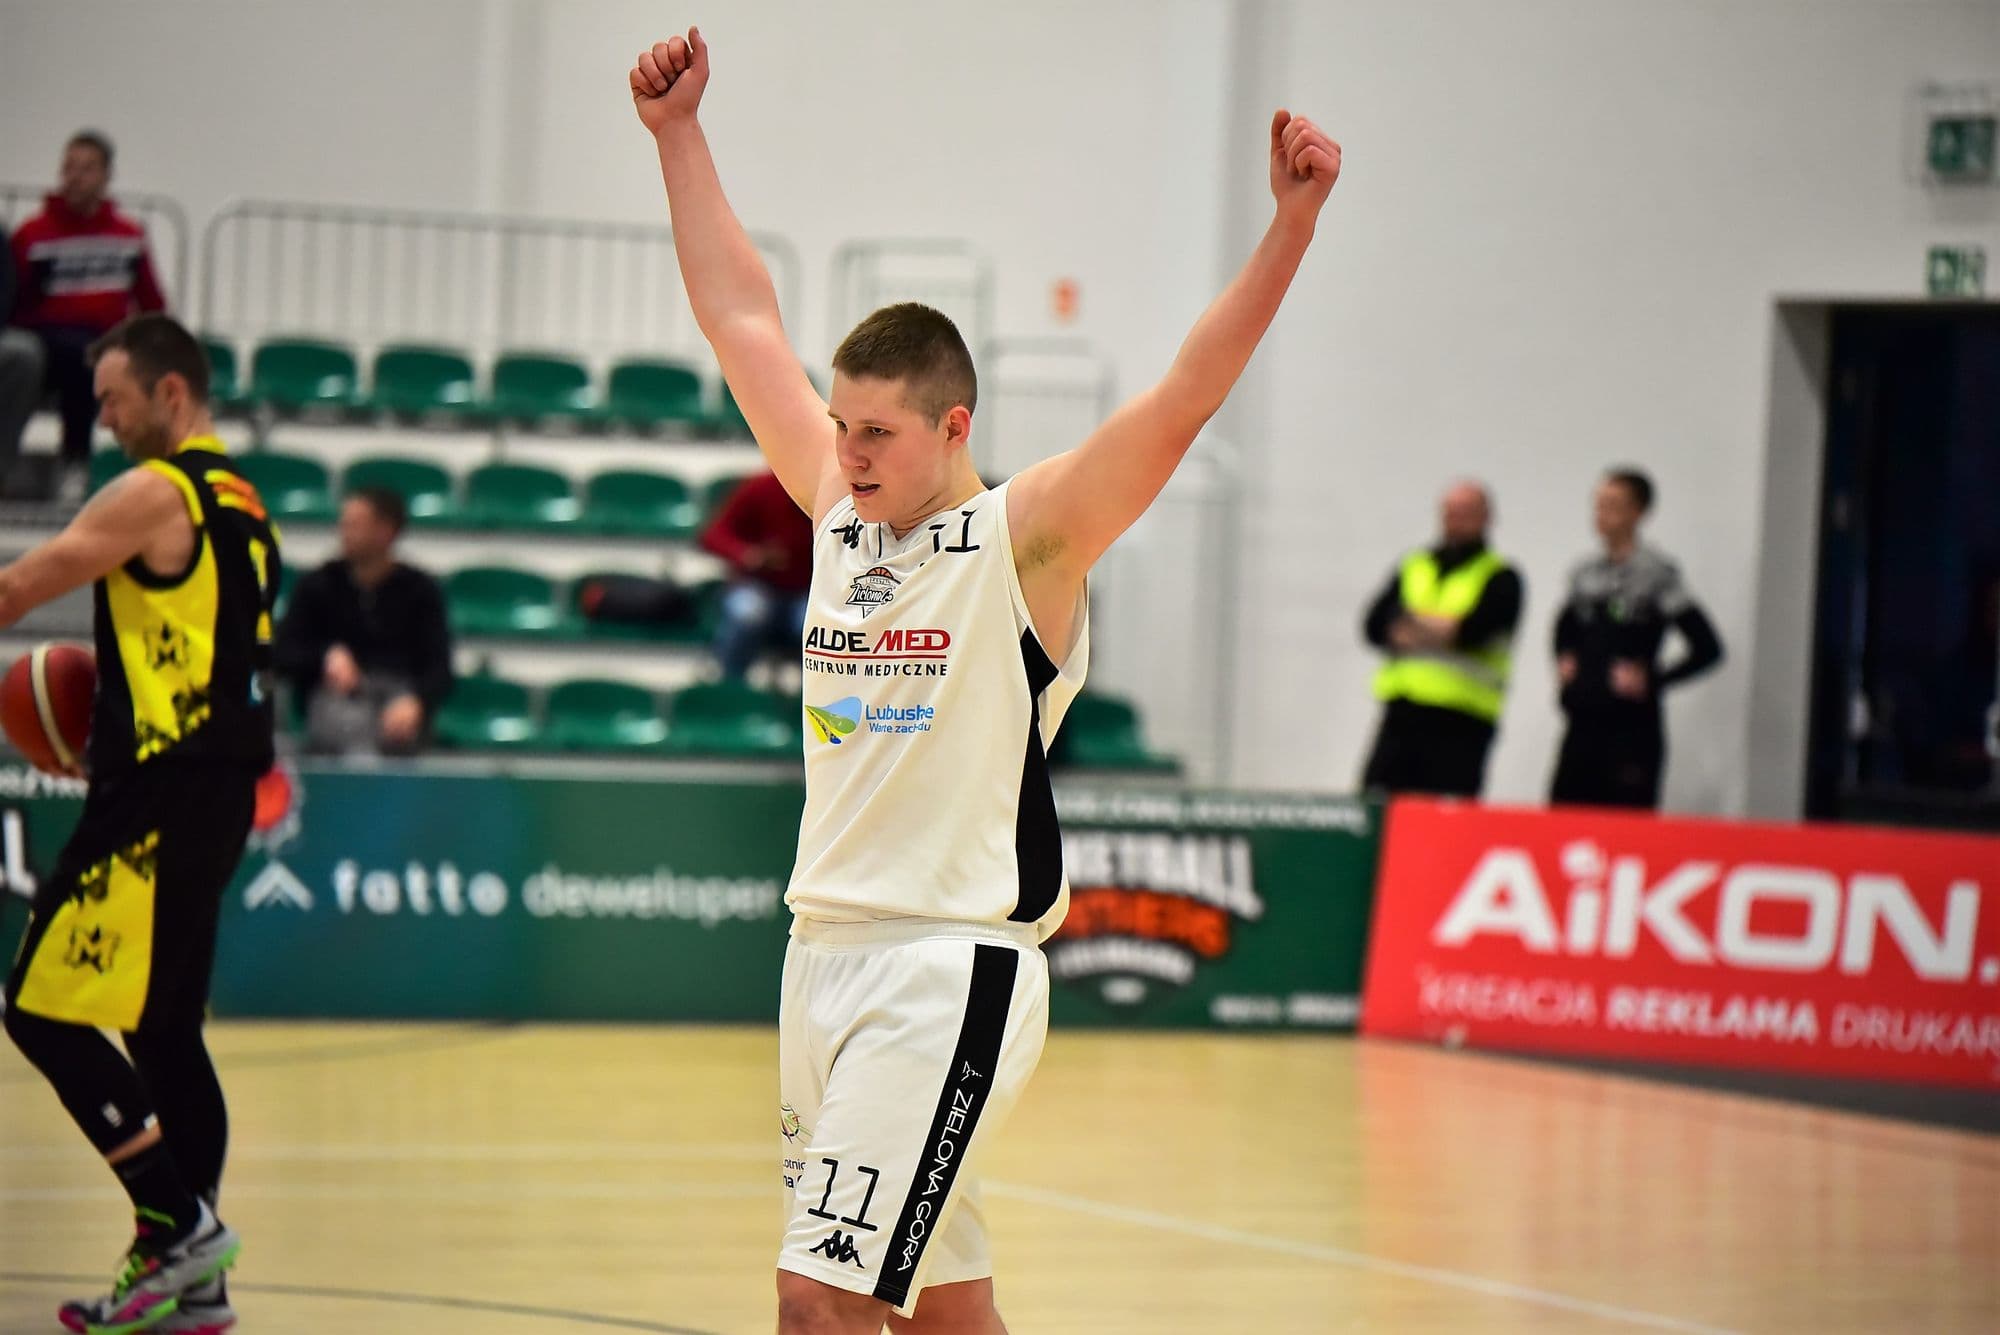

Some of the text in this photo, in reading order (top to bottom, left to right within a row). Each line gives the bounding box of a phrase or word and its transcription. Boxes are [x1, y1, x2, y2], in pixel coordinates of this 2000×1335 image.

[805, 626, 951, 654] ALDE MED
[805, 657, 947, 676] CENTRUM MEDYCZNE
[1606, 985, 1818, 1044] REKLAMA
[921, 1088, 974, 1196] ZIELONA
[808, 1157, 880, 1232] 11
